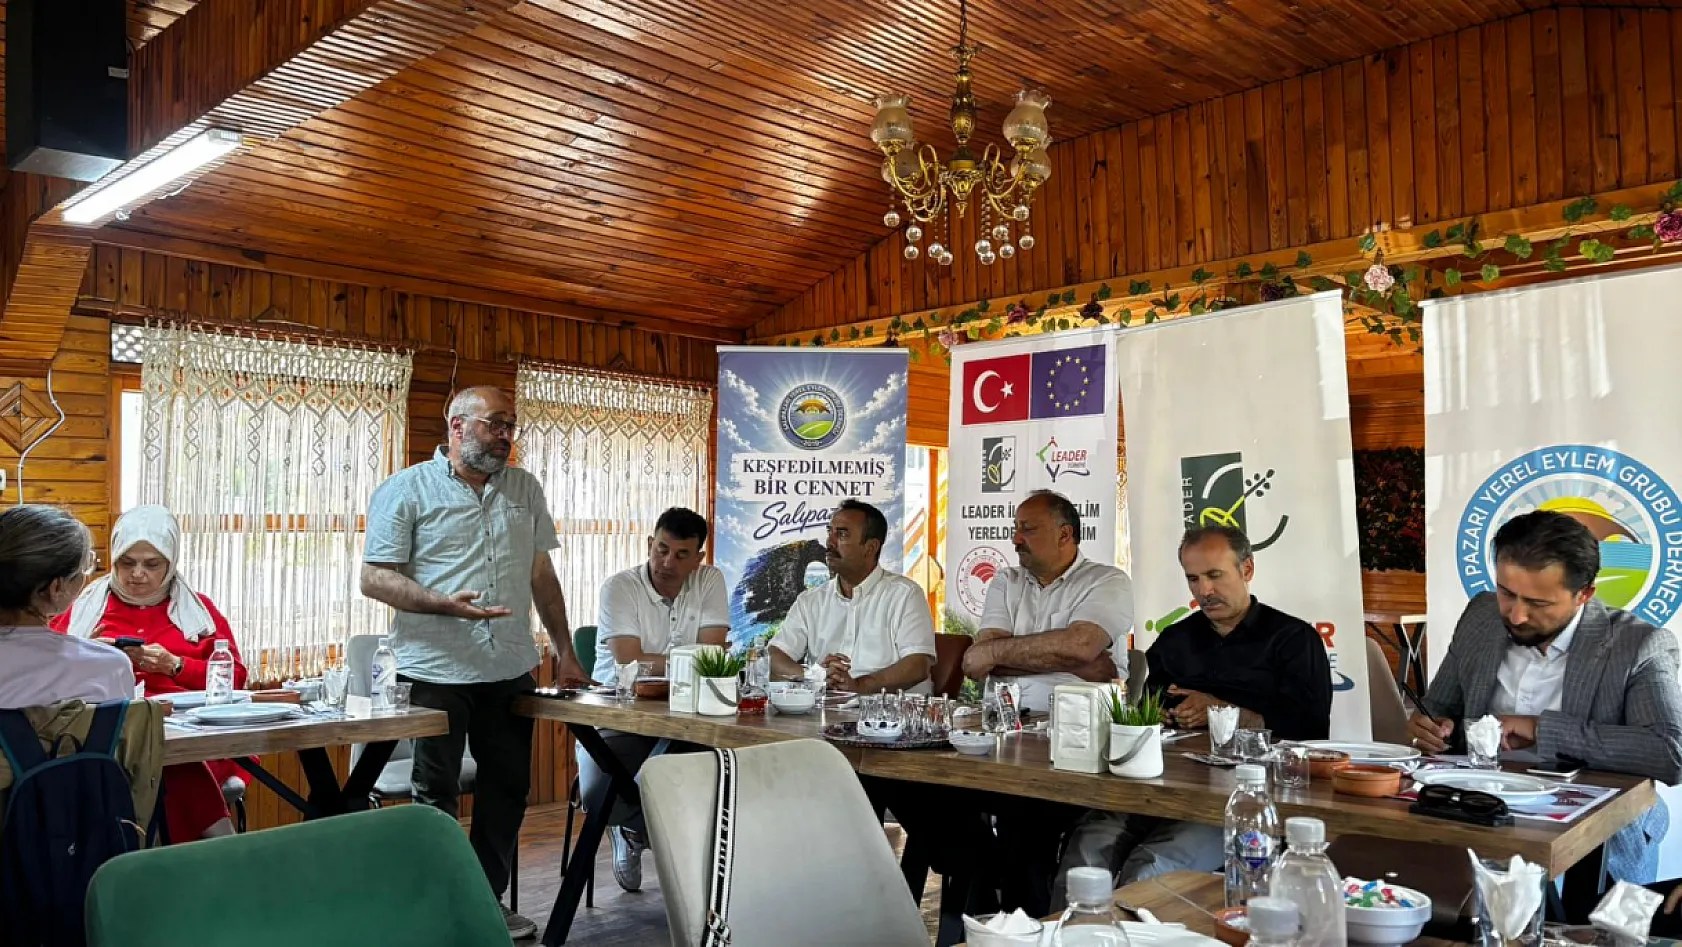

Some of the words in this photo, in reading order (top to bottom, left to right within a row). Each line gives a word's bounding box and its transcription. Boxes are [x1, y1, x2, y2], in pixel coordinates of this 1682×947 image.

[1051, 449, 1087, 463] LEADER
[743, 457, 885, 478] KEŞFEDİLMEMİŞ
[754, 473, 787, 495] BİR
[793, 479, 875, 497] CENNET
[962, 504, 1005, 519] LEADER
[1182, 477, 1196, 530] ADER
[1463, 506, 1489, 576] PAZARI
[1479, 462, 1538, 504] YEREL
[1542, 452, 1617, 474] EYLEM
[1619, 466, 1681, 526] GRUBU
